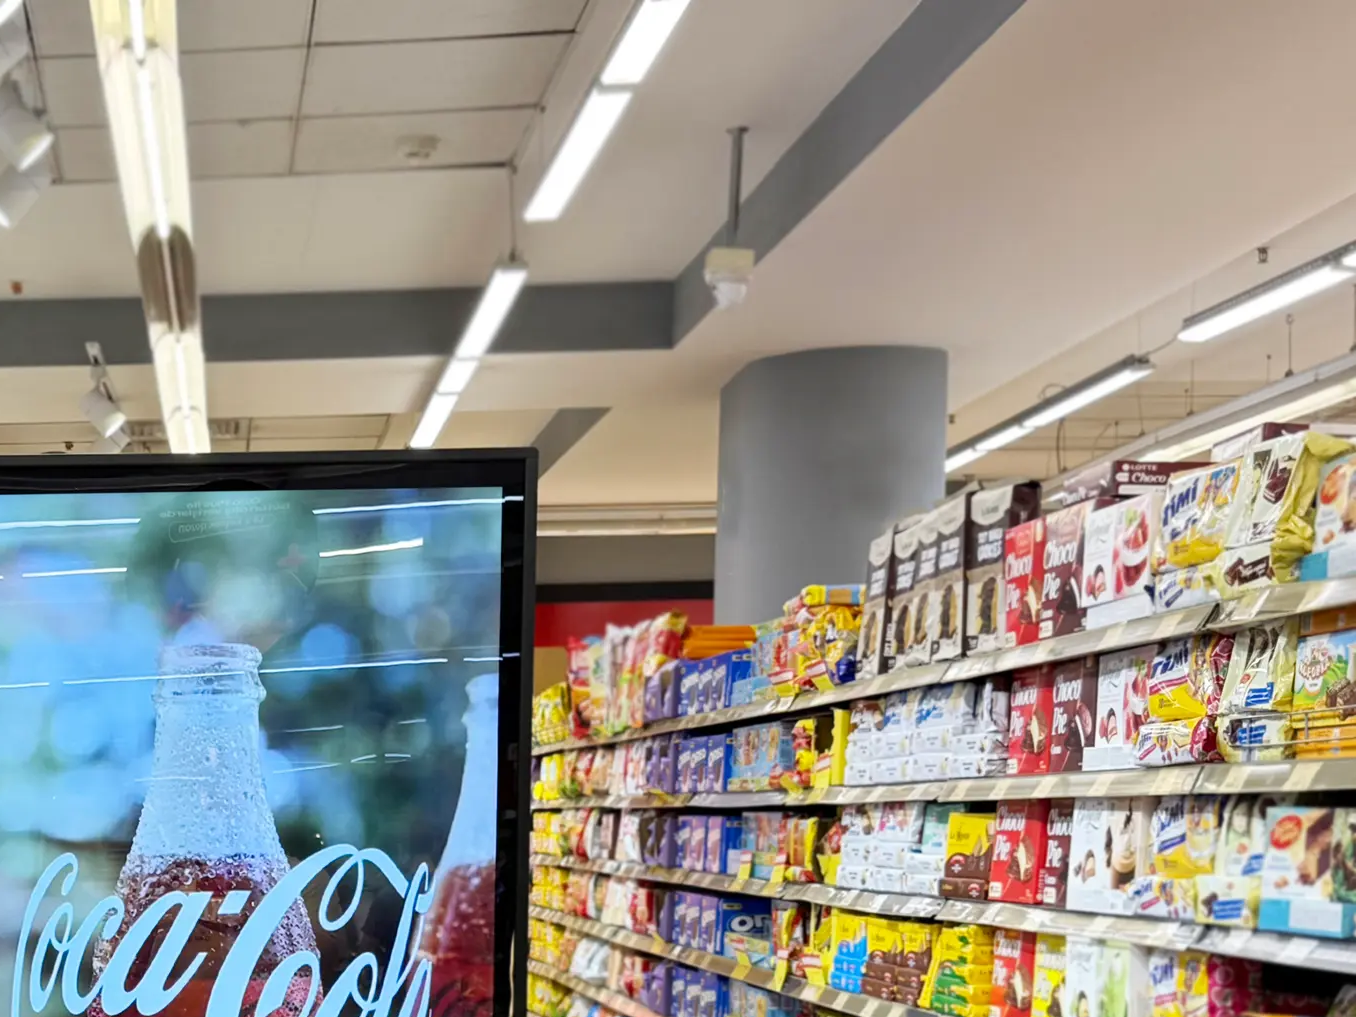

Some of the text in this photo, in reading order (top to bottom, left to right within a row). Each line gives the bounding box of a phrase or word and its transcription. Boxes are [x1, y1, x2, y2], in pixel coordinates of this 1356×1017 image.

[1131, 472, 1167, 483] Choco
[1005, 553, 1033, 581] Choco
[1044, 541, 1078, 571] Choco
[1005, 583, 1021, 610] Pie
[1043, 573, 1061, 601] Pie
[1052, 674, 1082, 704] Choco
[1009, 709, 1025, 738] Pie
[1051, 706, 1068, 735] Pie
[995, 805, 1026, 832] Choco
[993, 834, 1011, 861] Pie
[1045, 840, 1063, 868] Pie
